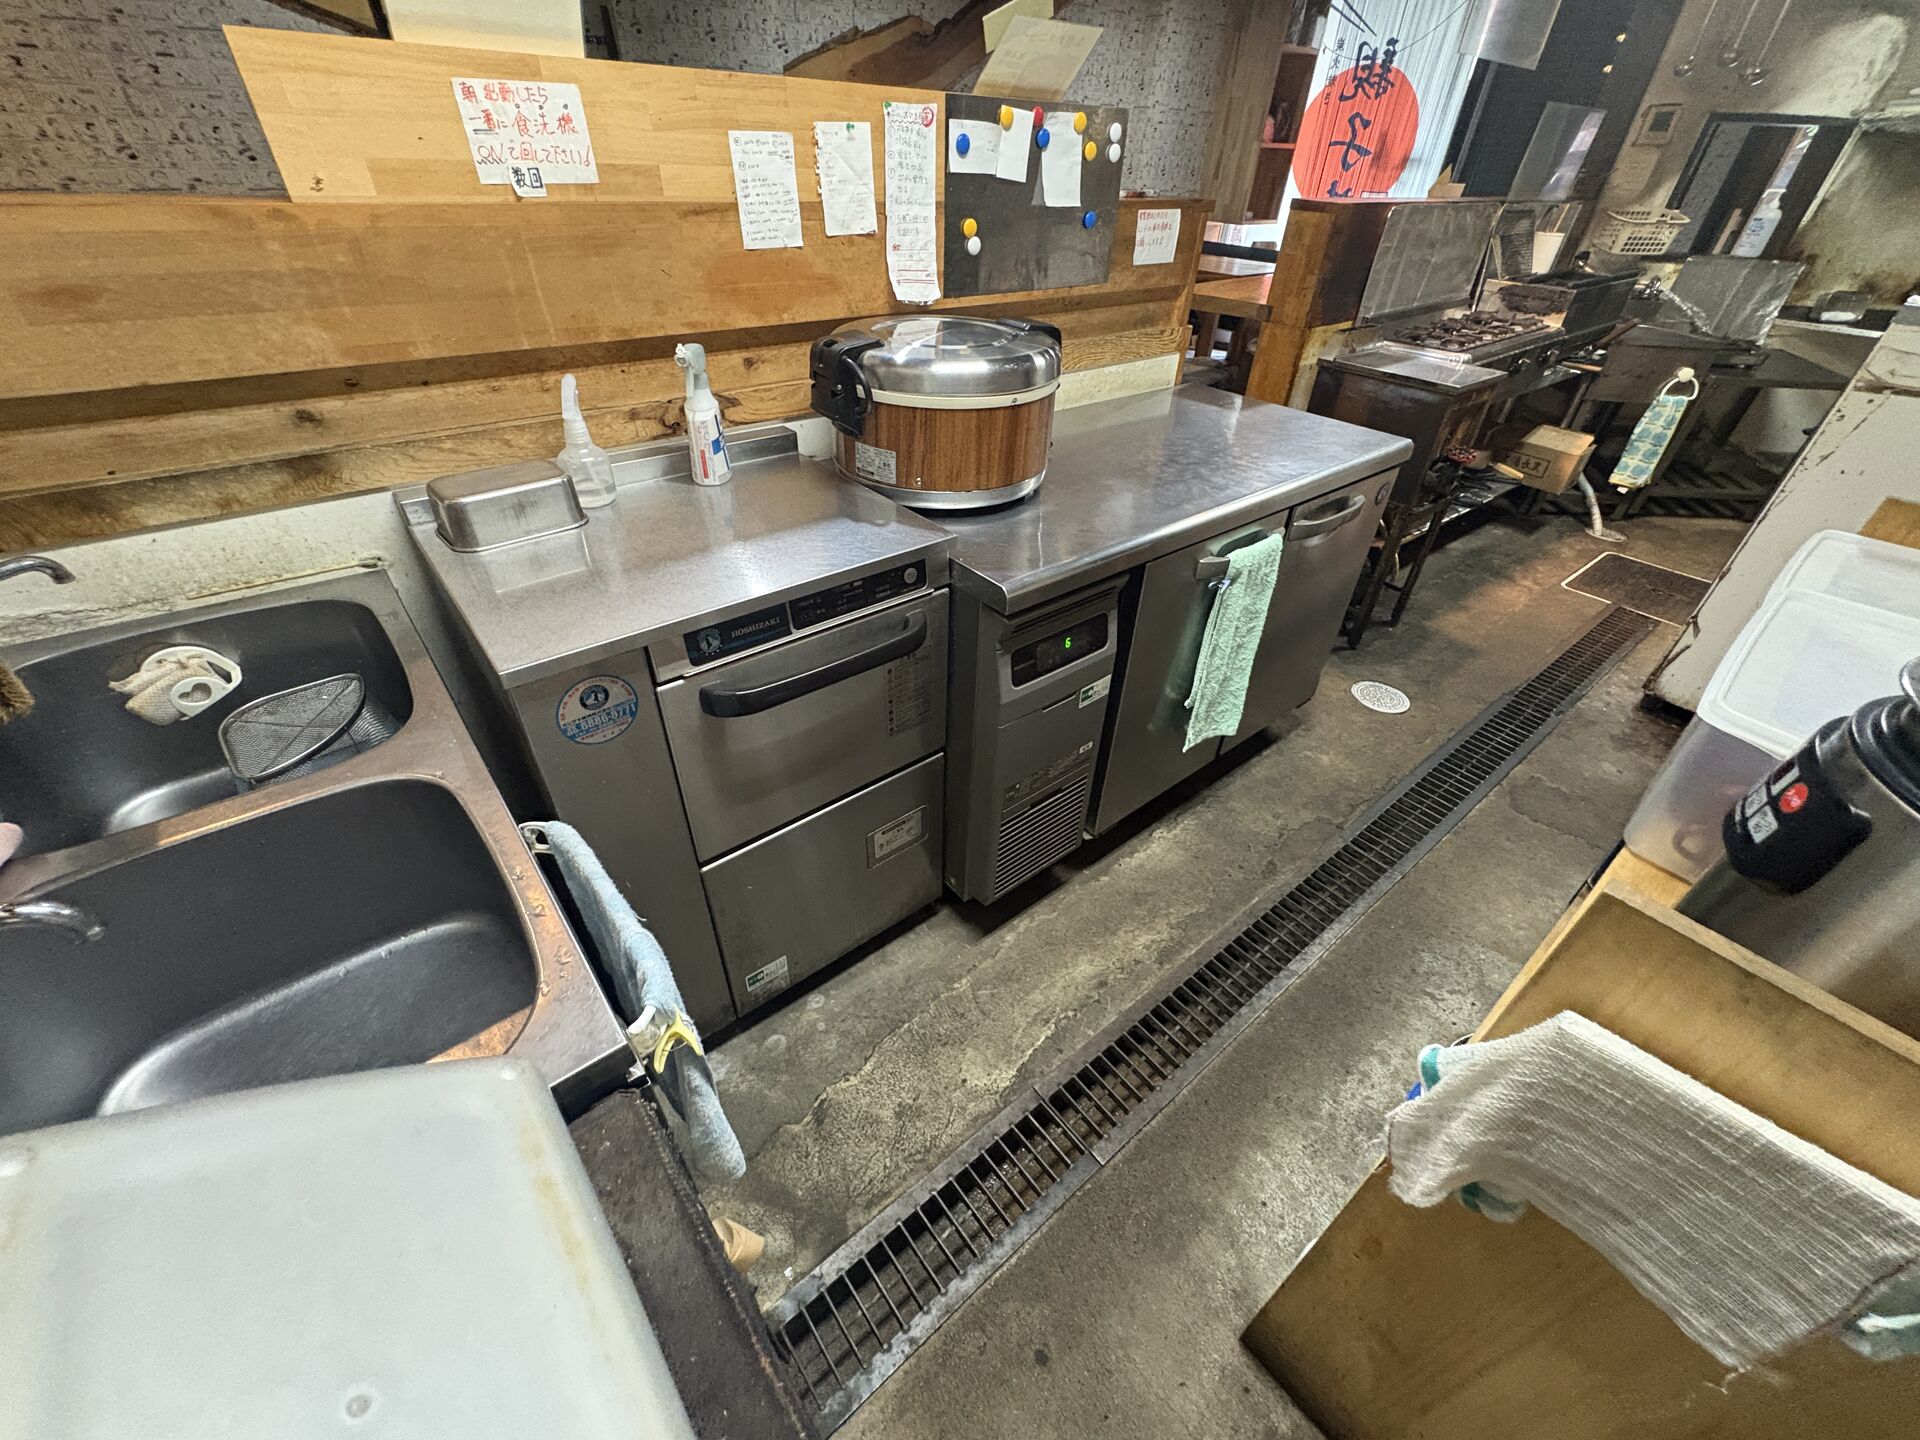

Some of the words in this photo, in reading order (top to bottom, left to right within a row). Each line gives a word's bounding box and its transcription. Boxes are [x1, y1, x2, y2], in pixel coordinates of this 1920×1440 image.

[511, 166, 544, 189] 数回
[730, 616, 781, 639] HOSHIZAKI
[1065, 637, 1071, 649] 6
